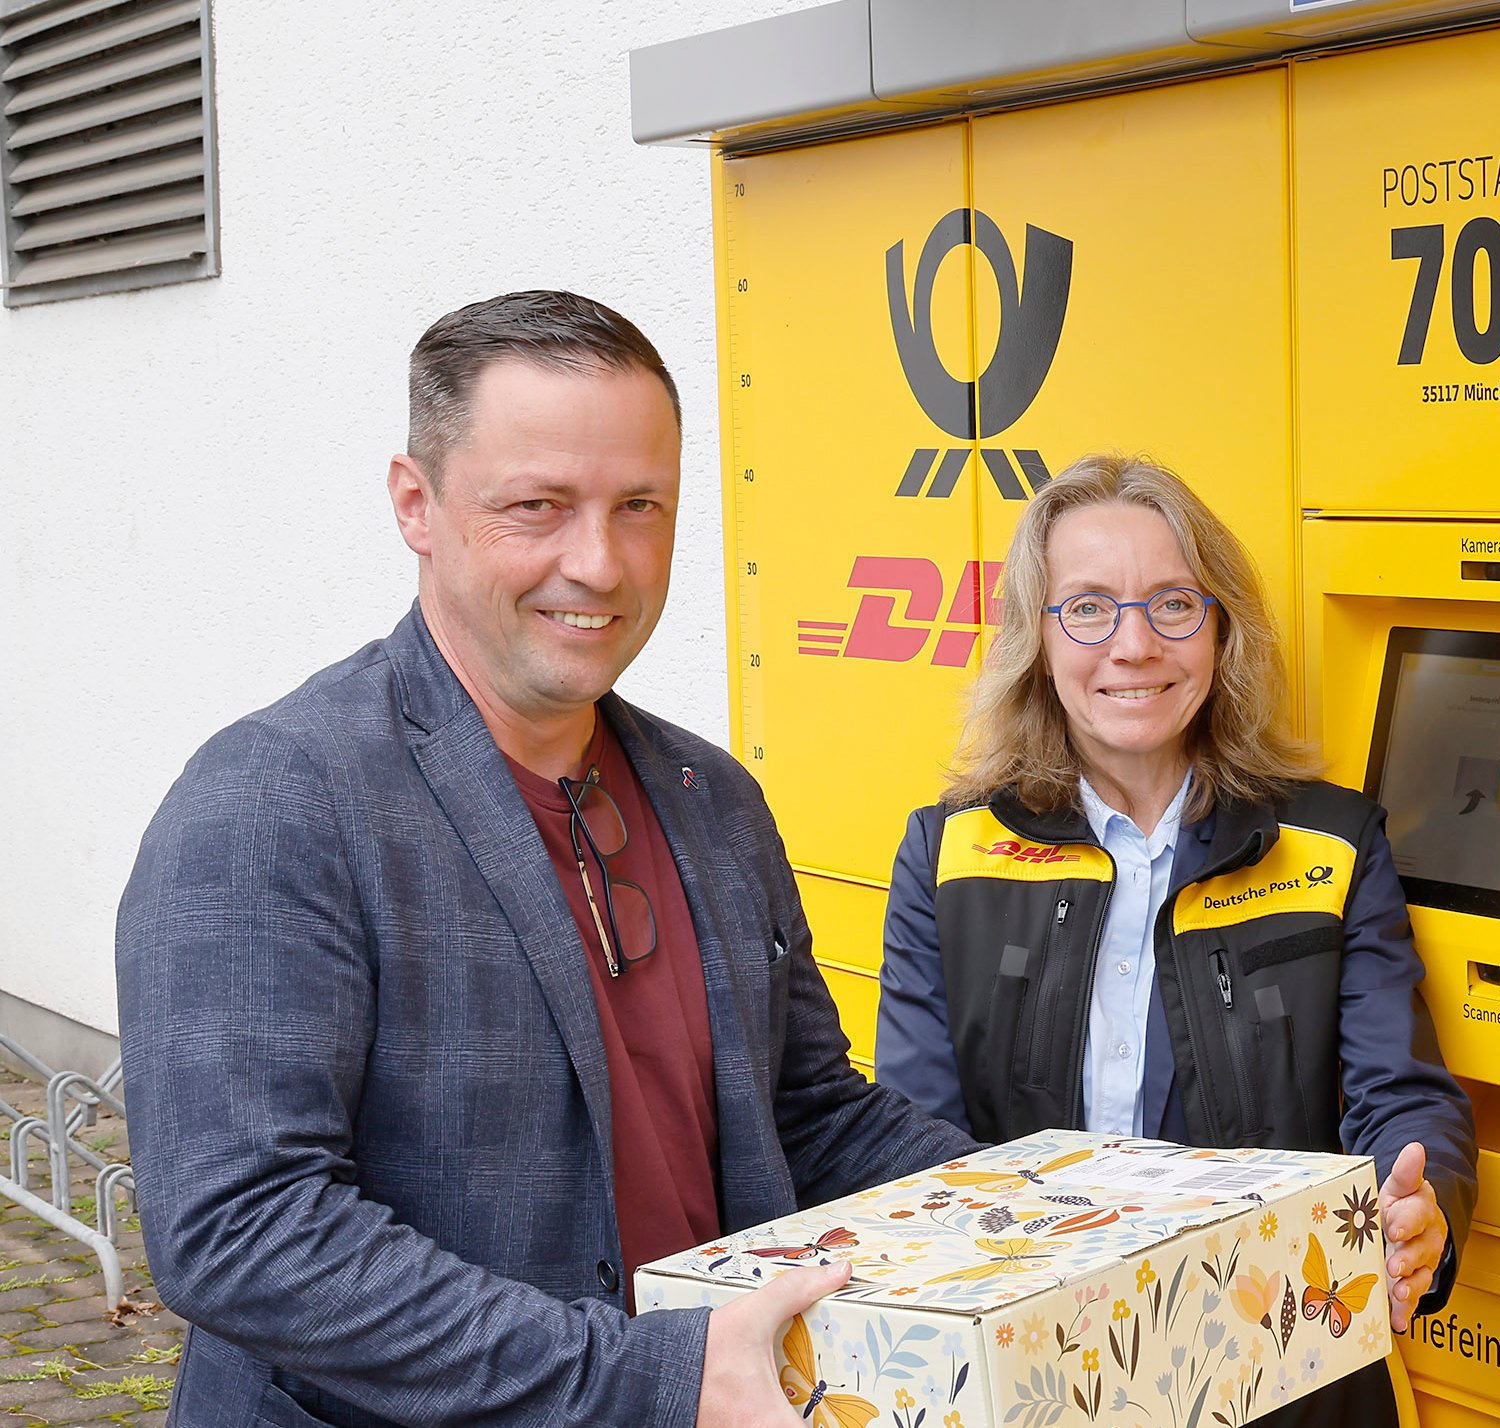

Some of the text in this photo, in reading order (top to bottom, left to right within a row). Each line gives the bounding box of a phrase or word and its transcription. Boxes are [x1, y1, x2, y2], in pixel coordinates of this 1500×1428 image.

[734, 183, 745, 198] 70
[737, 278, 748, 293] 60
[740, 374, 751, 388] 50
[1421, 383, 1460, 403] 35117
[743, 468, 754, 483] 40
[747, 562, 757, 576] 30
[750, 654, 760, 668] 20
[753, 746, 764, 760] 10
[985, 840, 1066, 864] DHL
[1203, 878, 1301, 910] Deutsche Post
